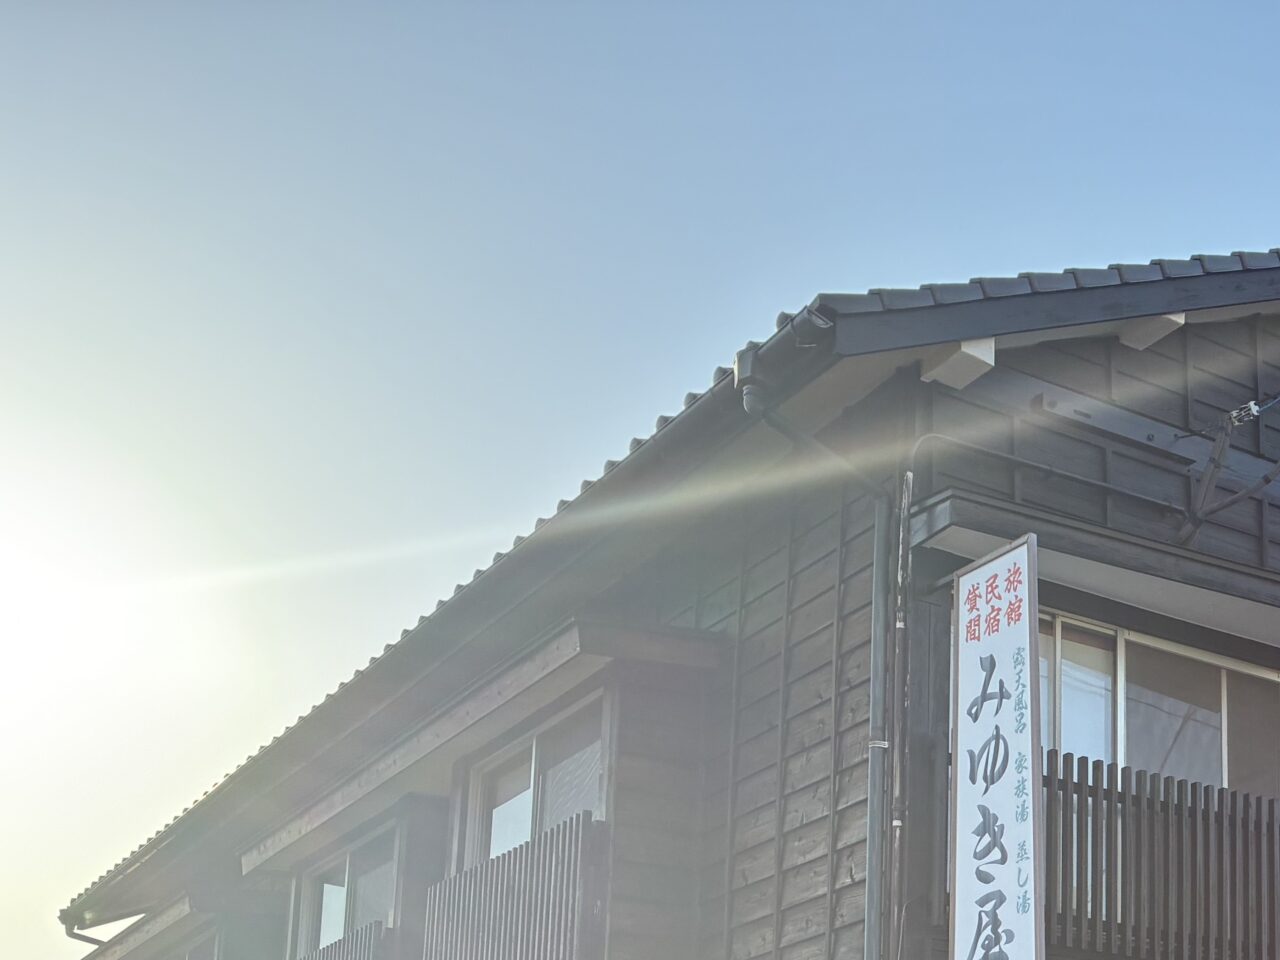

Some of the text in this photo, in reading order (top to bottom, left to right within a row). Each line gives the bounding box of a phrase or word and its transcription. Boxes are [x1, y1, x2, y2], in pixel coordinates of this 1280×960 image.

[963, 582, 982, 643] 貸間
[984, 573, 1002, 637] 民宿
[1004, 562, 1023, 628] 旅館
[1014, 752, 1029, 823] 家族湯
[1015, 841, 1031, 915] 蒸し湯
